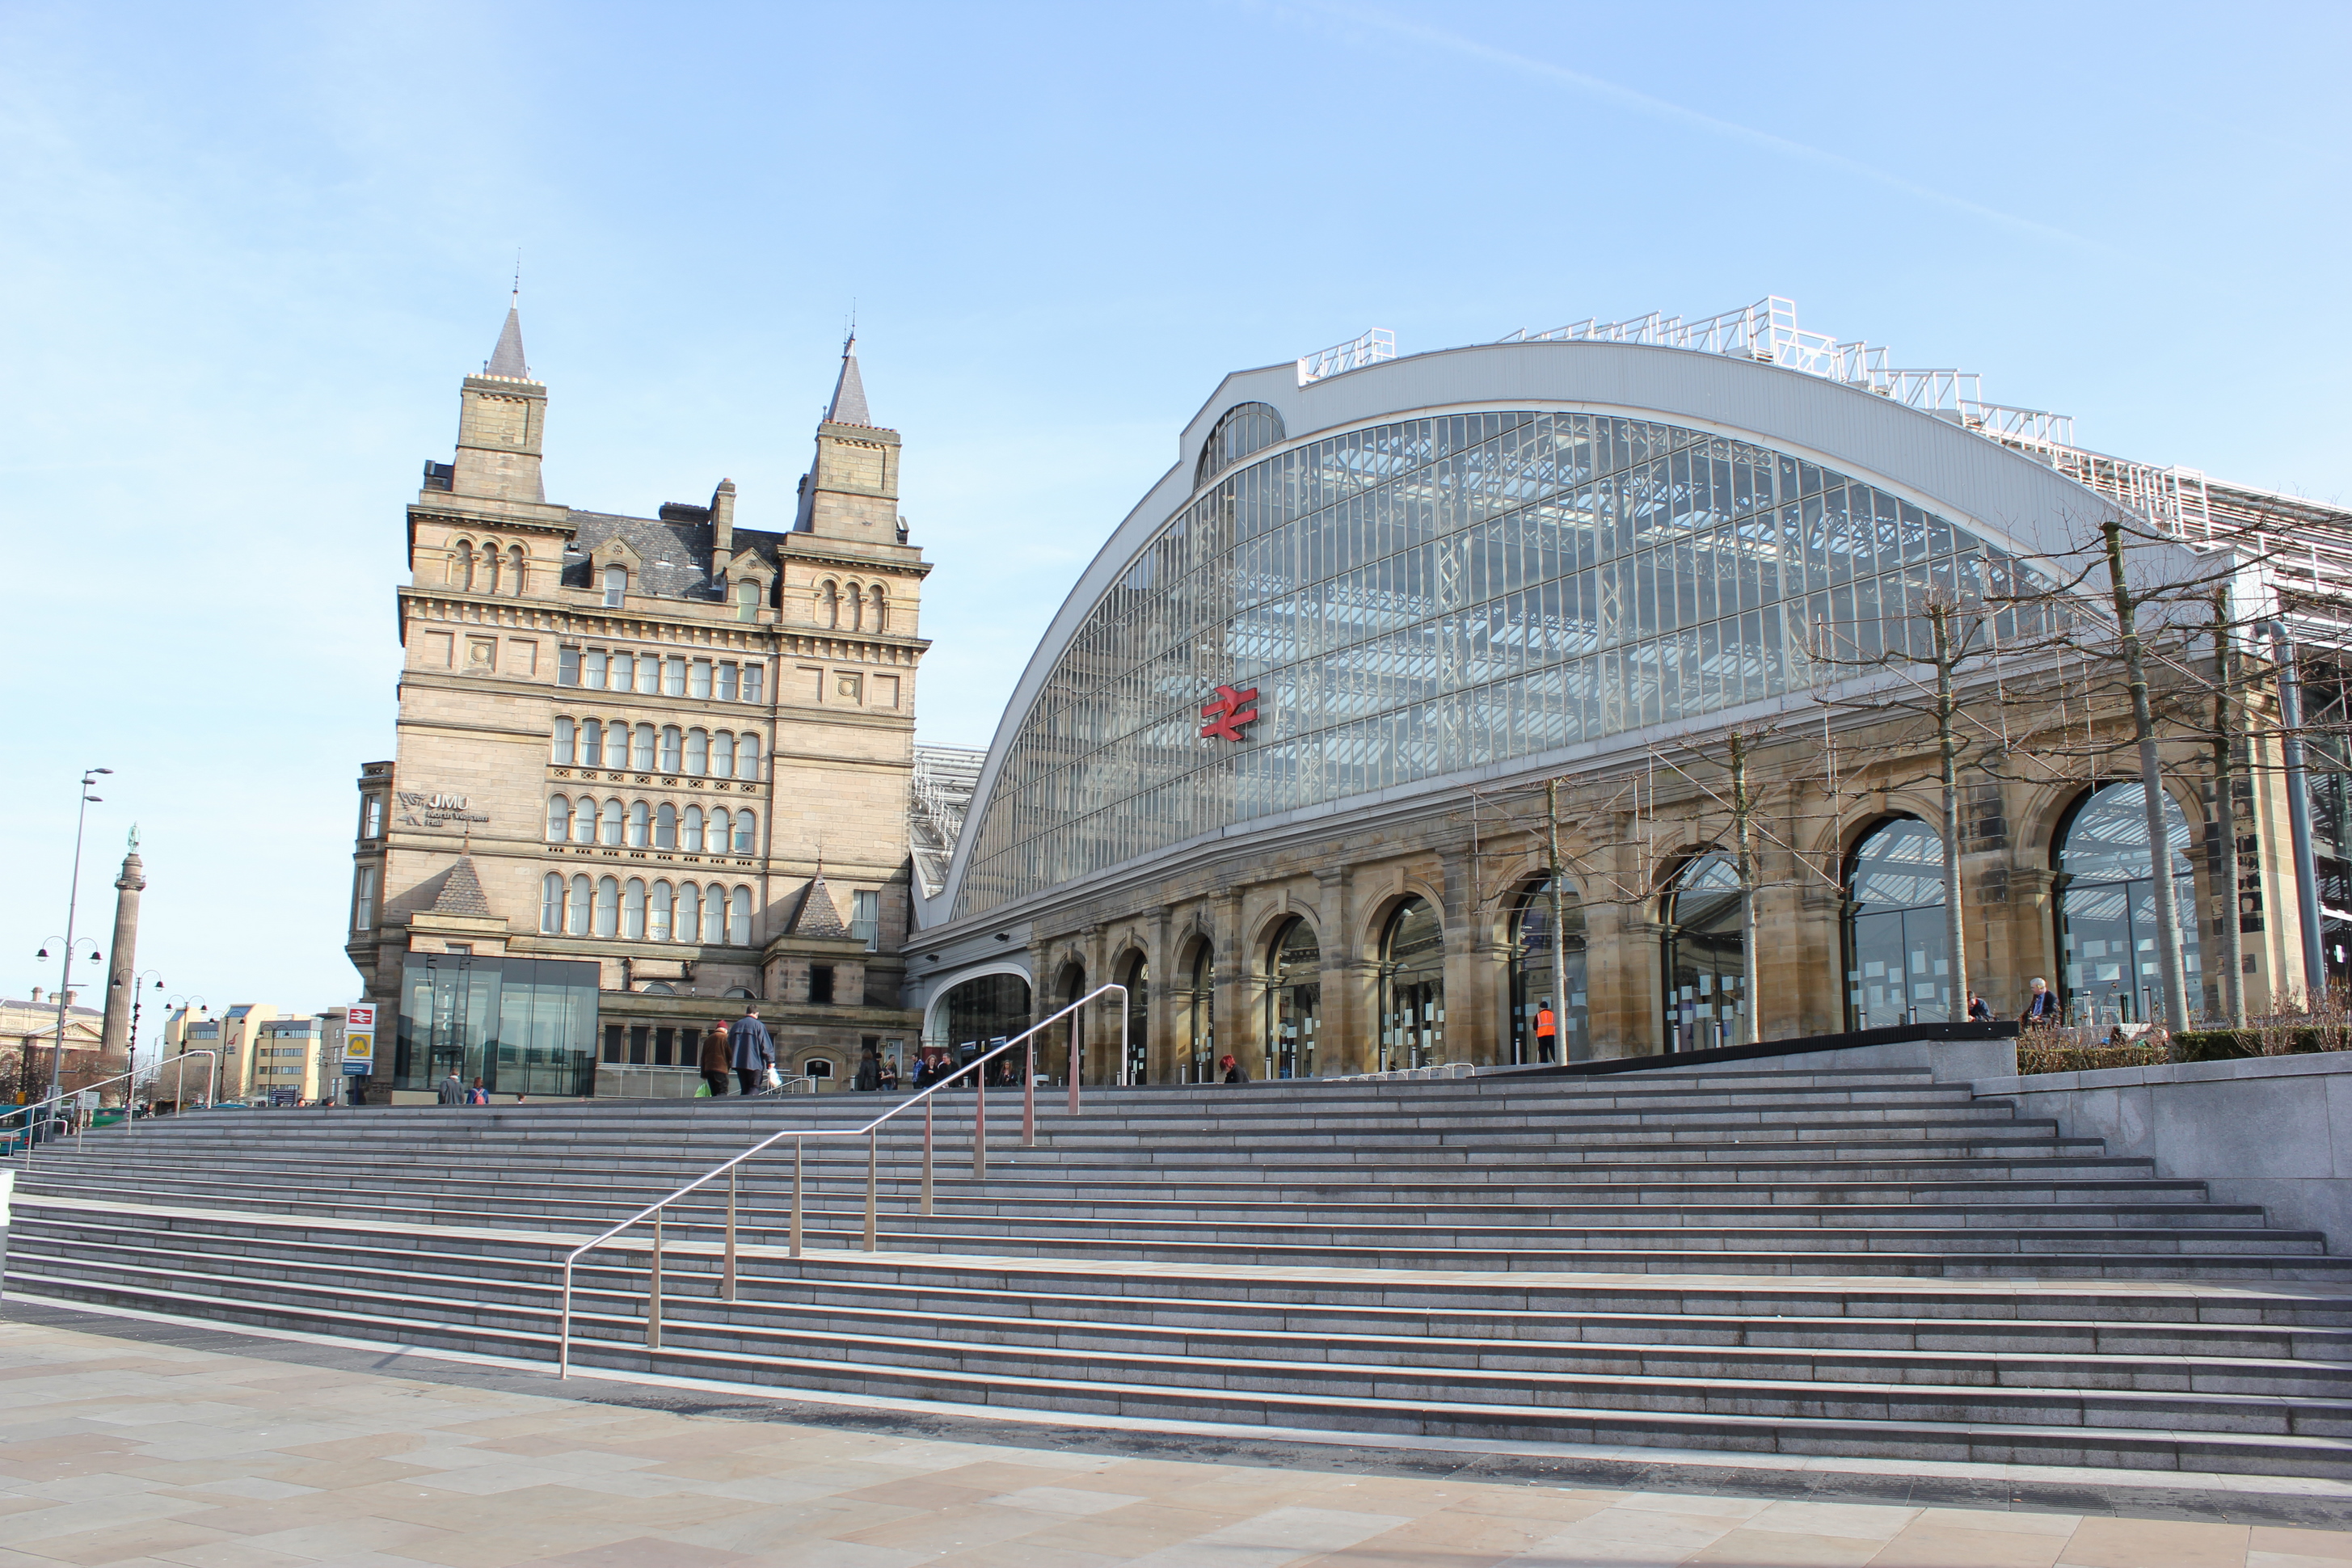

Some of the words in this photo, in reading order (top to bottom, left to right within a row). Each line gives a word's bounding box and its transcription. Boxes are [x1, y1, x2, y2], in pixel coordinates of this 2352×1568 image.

[428, 794, 469, 810] JMU
[427, 811, 453, 820] North
[455, 811, 490, 822] Western
[427, 818, 443, 827] Hall
